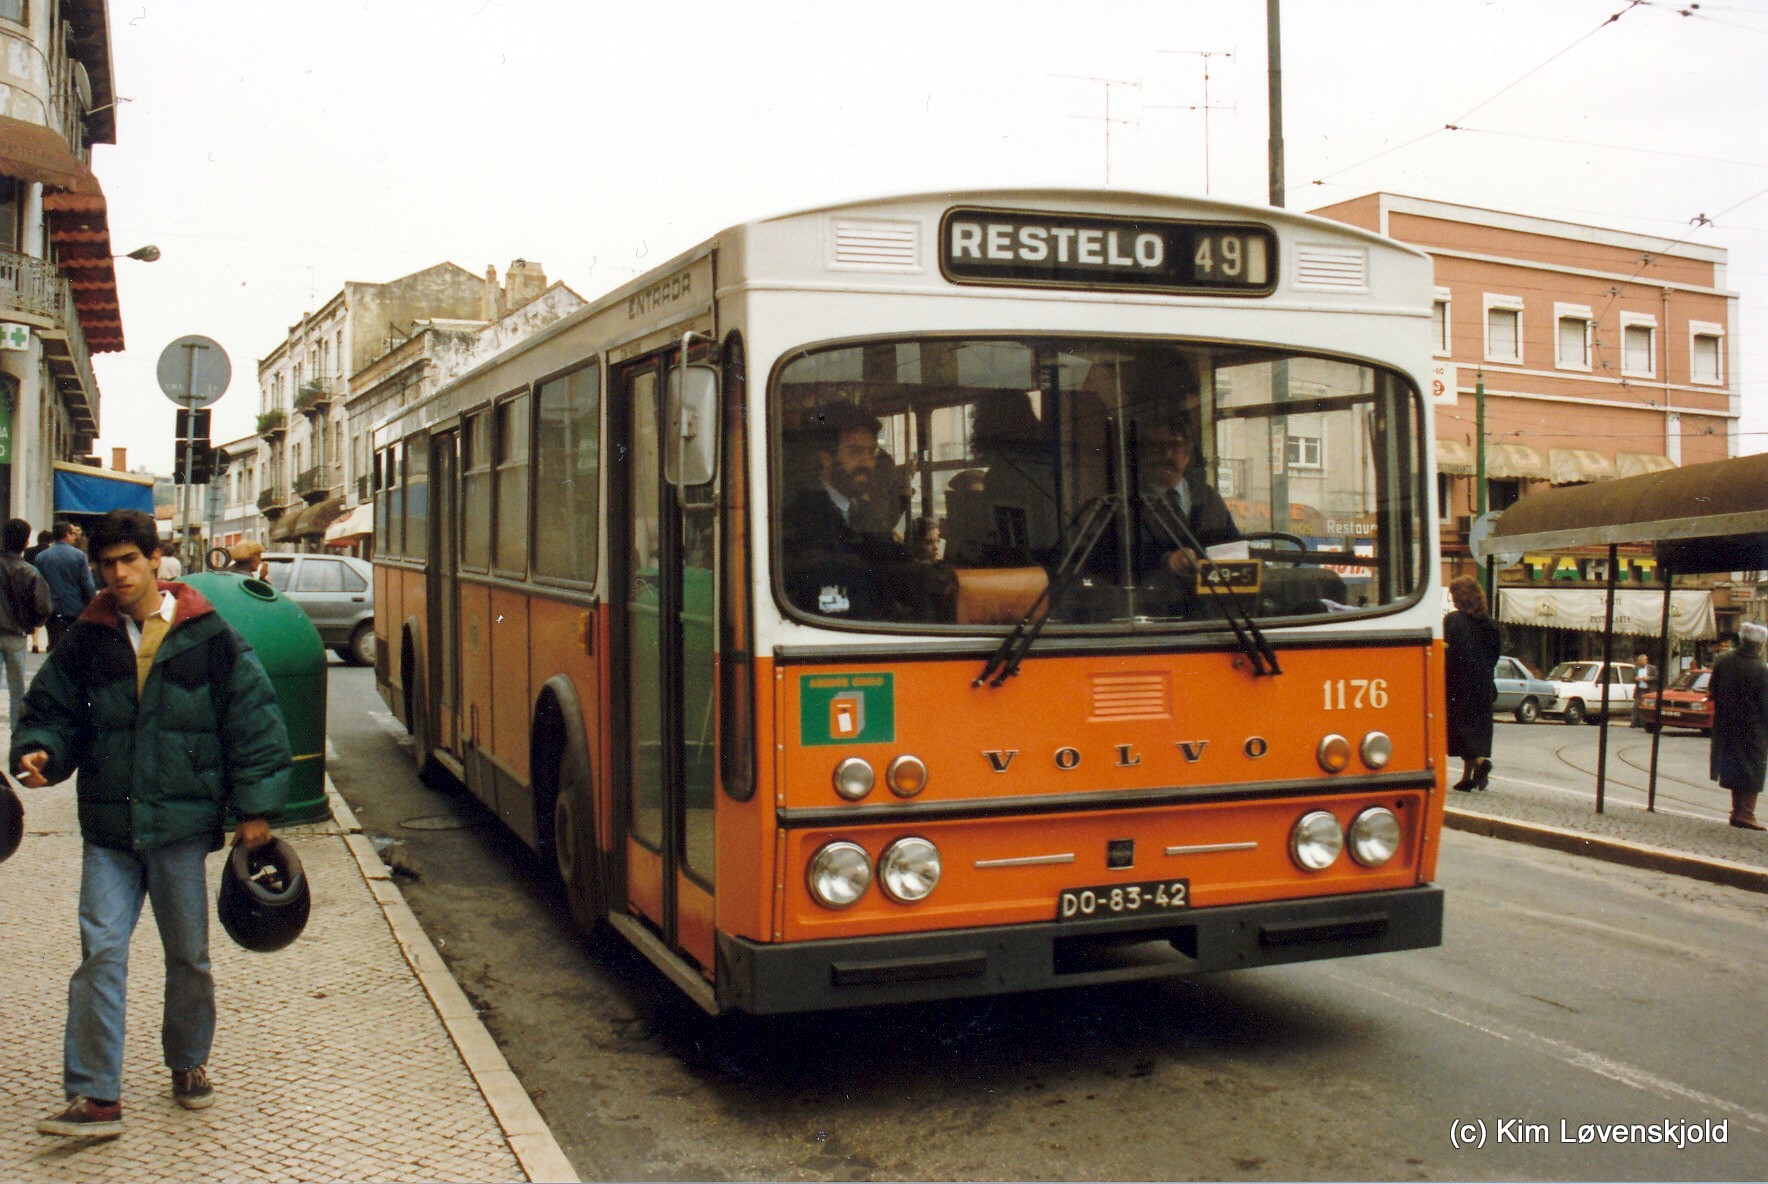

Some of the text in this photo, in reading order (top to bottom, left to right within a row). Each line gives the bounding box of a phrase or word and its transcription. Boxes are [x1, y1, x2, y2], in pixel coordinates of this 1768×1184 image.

[951, 221, 1242, 277] RESTELO 49
[628, 271, 691, 320] ENTRADA
[1524, 556, 1658, 581] TAHIT
[1589, 615, 1631, 624] PASTARIA
[1322, 678, 1389, 710] 1176
[982, 736, 1269, 773] VOLVO
[1061, 882, 1188, 918] DO-83-42
